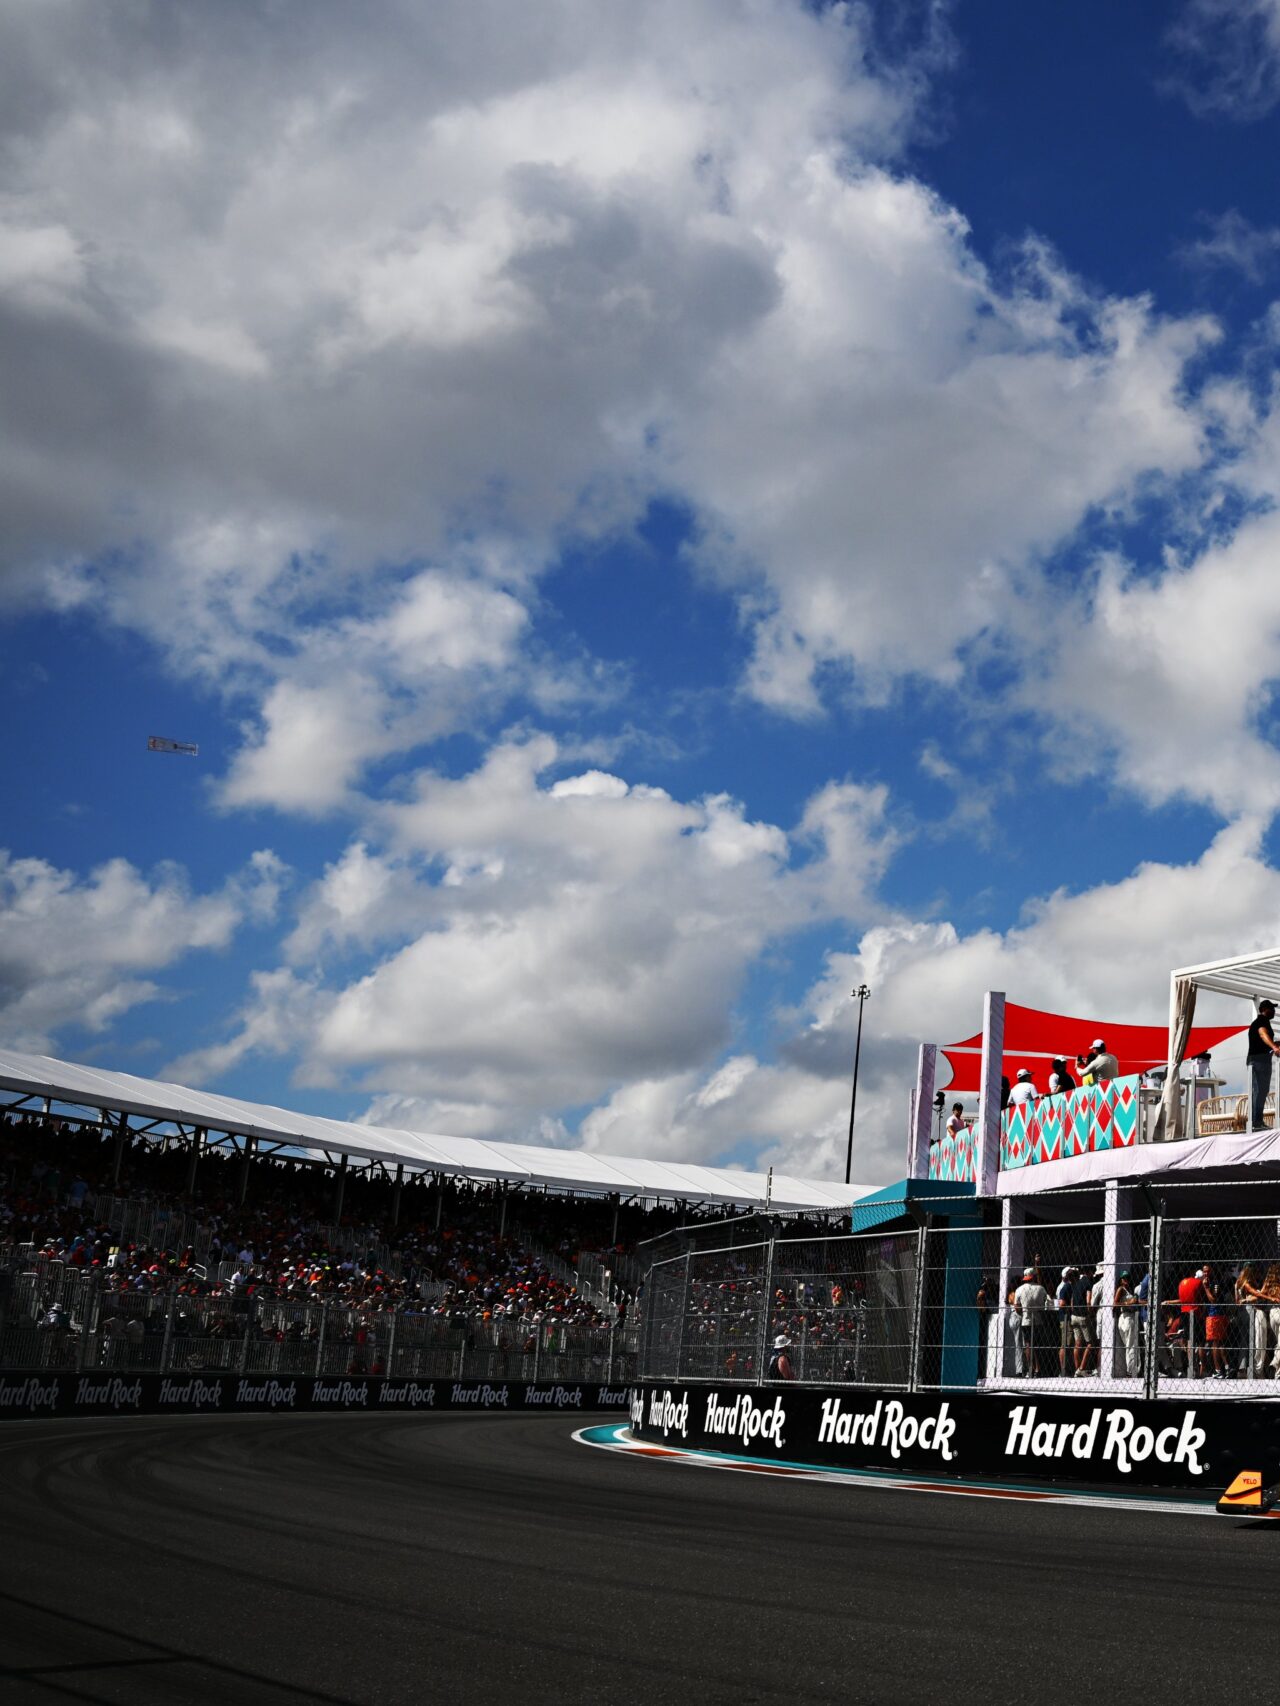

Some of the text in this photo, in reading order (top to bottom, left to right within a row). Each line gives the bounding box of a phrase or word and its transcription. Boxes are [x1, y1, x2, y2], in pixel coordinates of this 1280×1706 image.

[27, 1378, 59, 1411] Rock
[108, 1378, 142, 1408] Rock
[159, 1379, 221, 1408] Hard Rock
[236, 1380, 296, 1407] Hard Rock
[311, 1381, 368, 1406] Hard Rock
[379, 1382, 435, 1406] Hard Rock
[451, 1384, 509, 1406] Hard Rock
[525, 1386, 582, 1406] Hard Rock
[597, 1387, 627, 1404] Hard
[649, 1390, 689, 1438] Hard Rock
[704, 1393, 786, 1448] Hard Rock
[817, 1398, 956, 1461] Hard Rock
[1004, 1406, 1206, 1475] Hard Rock
